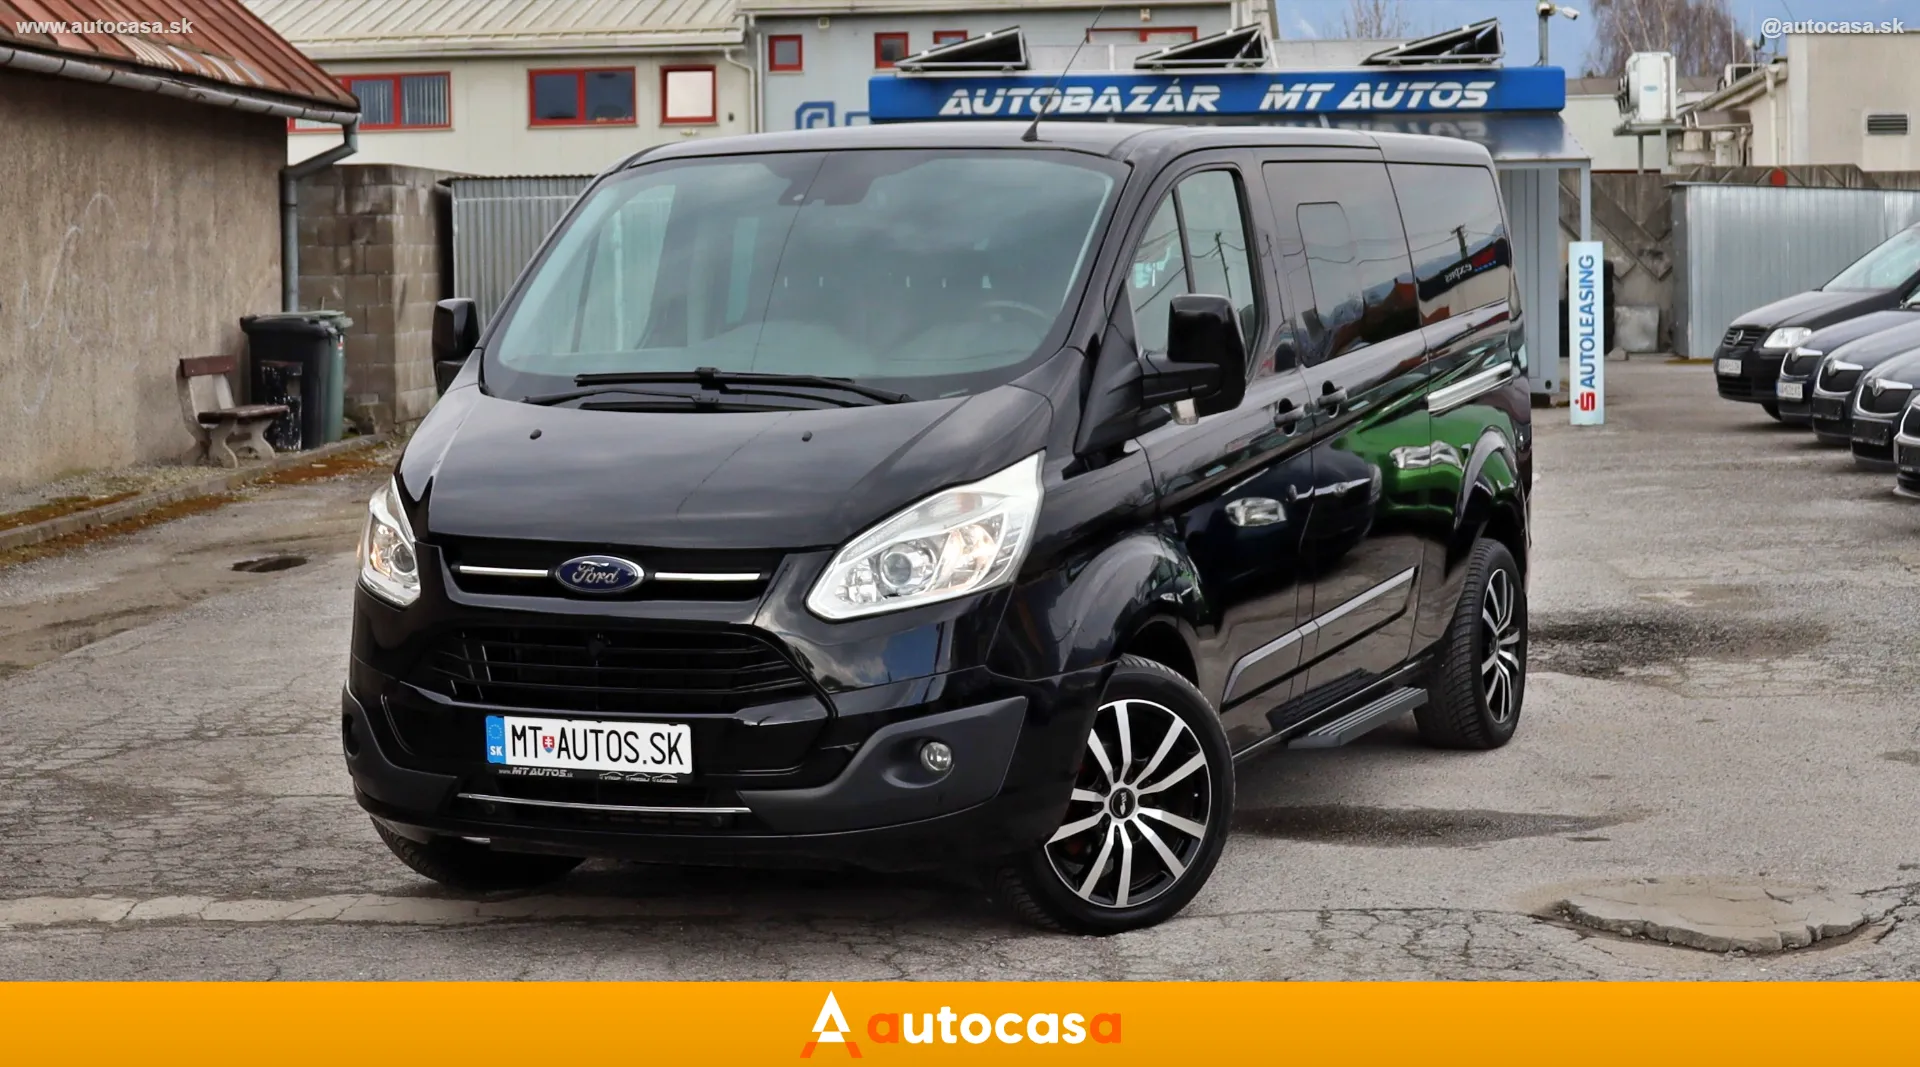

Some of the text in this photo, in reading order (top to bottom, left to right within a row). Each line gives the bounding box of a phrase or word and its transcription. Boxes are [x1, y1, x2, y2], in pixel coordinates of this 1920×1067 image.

[938, 78, 1496, 116] AUTOBAZÁR MT AUTOS
[1578, 254, 1596, 389] AUTOLEASING
[571, 560, 620, 584] Ford
[490, 746, 503, 757] SK
[511, 724, 684, 766] MT AUTOS.SK
